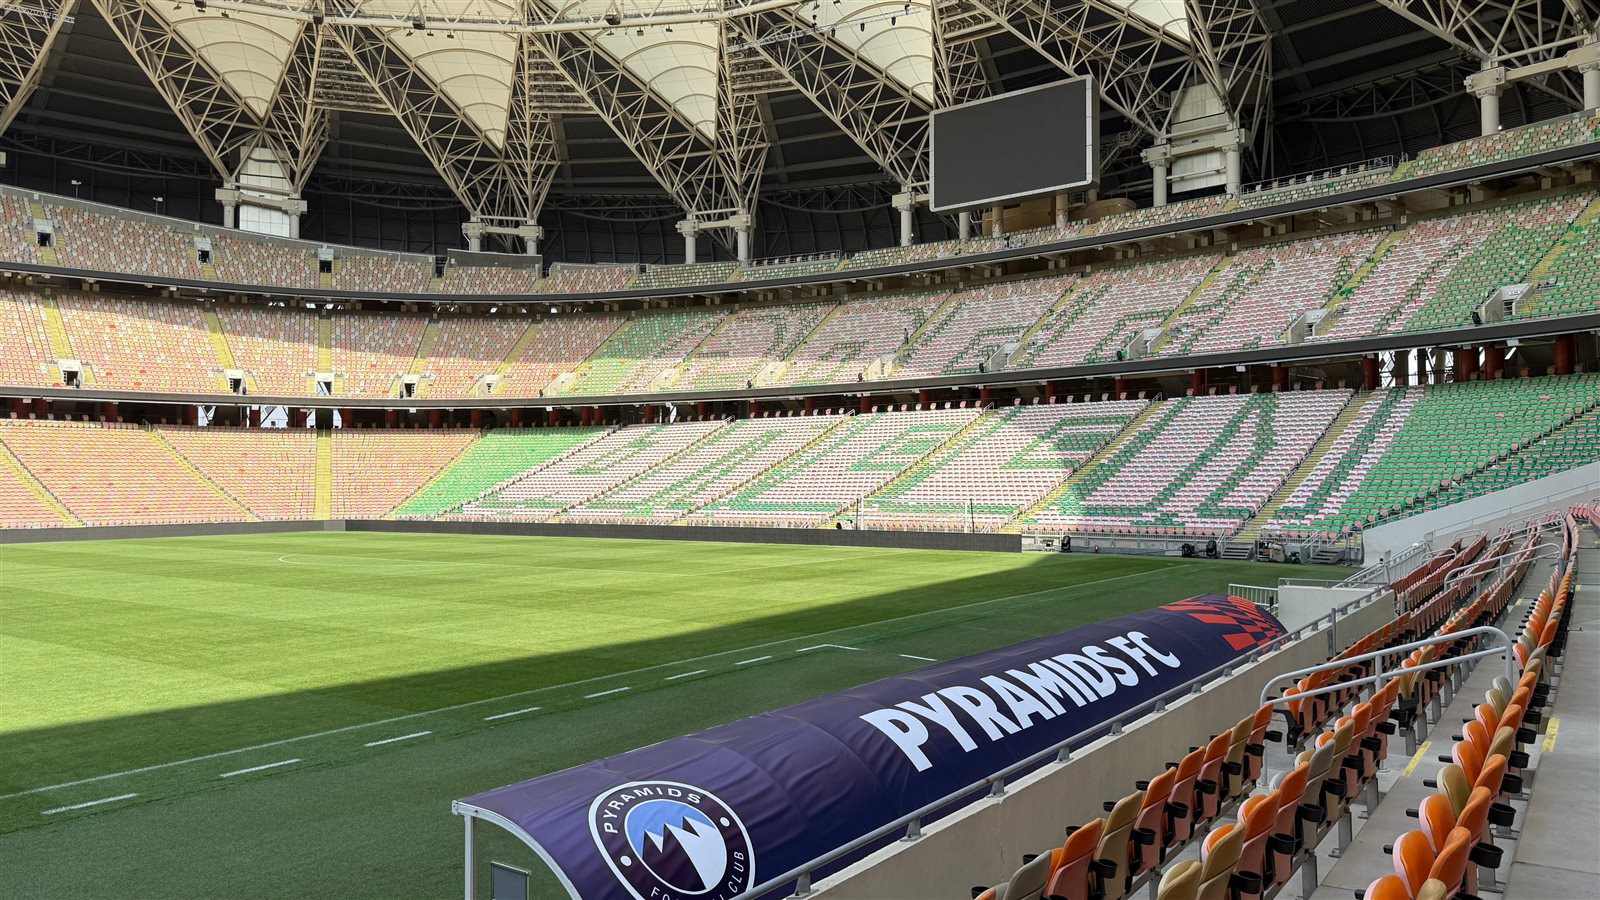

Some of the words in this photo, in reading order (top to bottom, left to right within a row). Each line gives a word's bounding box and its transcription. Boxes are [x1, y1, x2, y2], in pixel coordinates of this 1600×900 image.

[860, 645, 1139, 772] PYRAMIDS
[1104, 631, 1181, 677] FC
[603, 787, 702, 834] PYRAMIDS
[728, 851, 745, 893] CLUB
